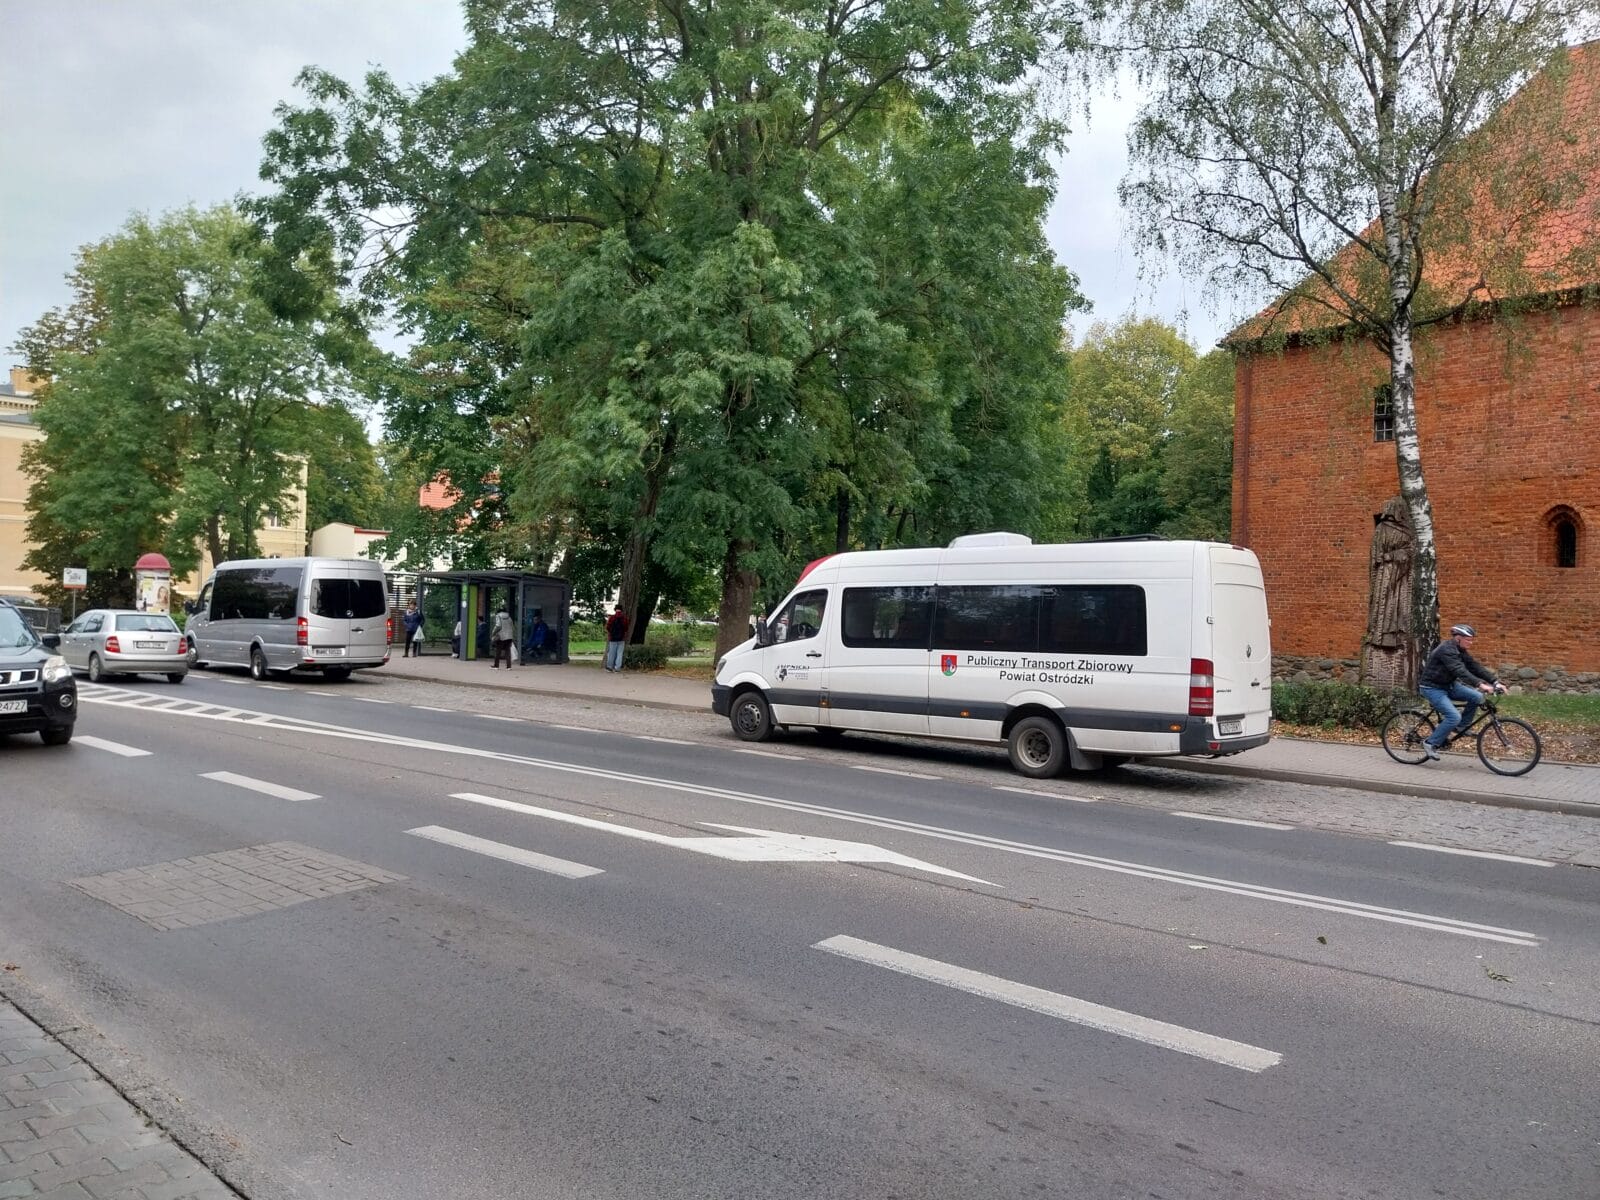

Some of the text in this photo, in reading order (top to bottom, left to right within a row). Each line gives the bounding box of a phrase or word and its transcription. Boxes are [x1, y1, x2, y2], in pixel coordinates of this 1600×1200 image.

[967, 655, 1134, 674] Publiczny Transport Zbiorowy
[999, 670, 1094, 685] Powiat Ostródzki
